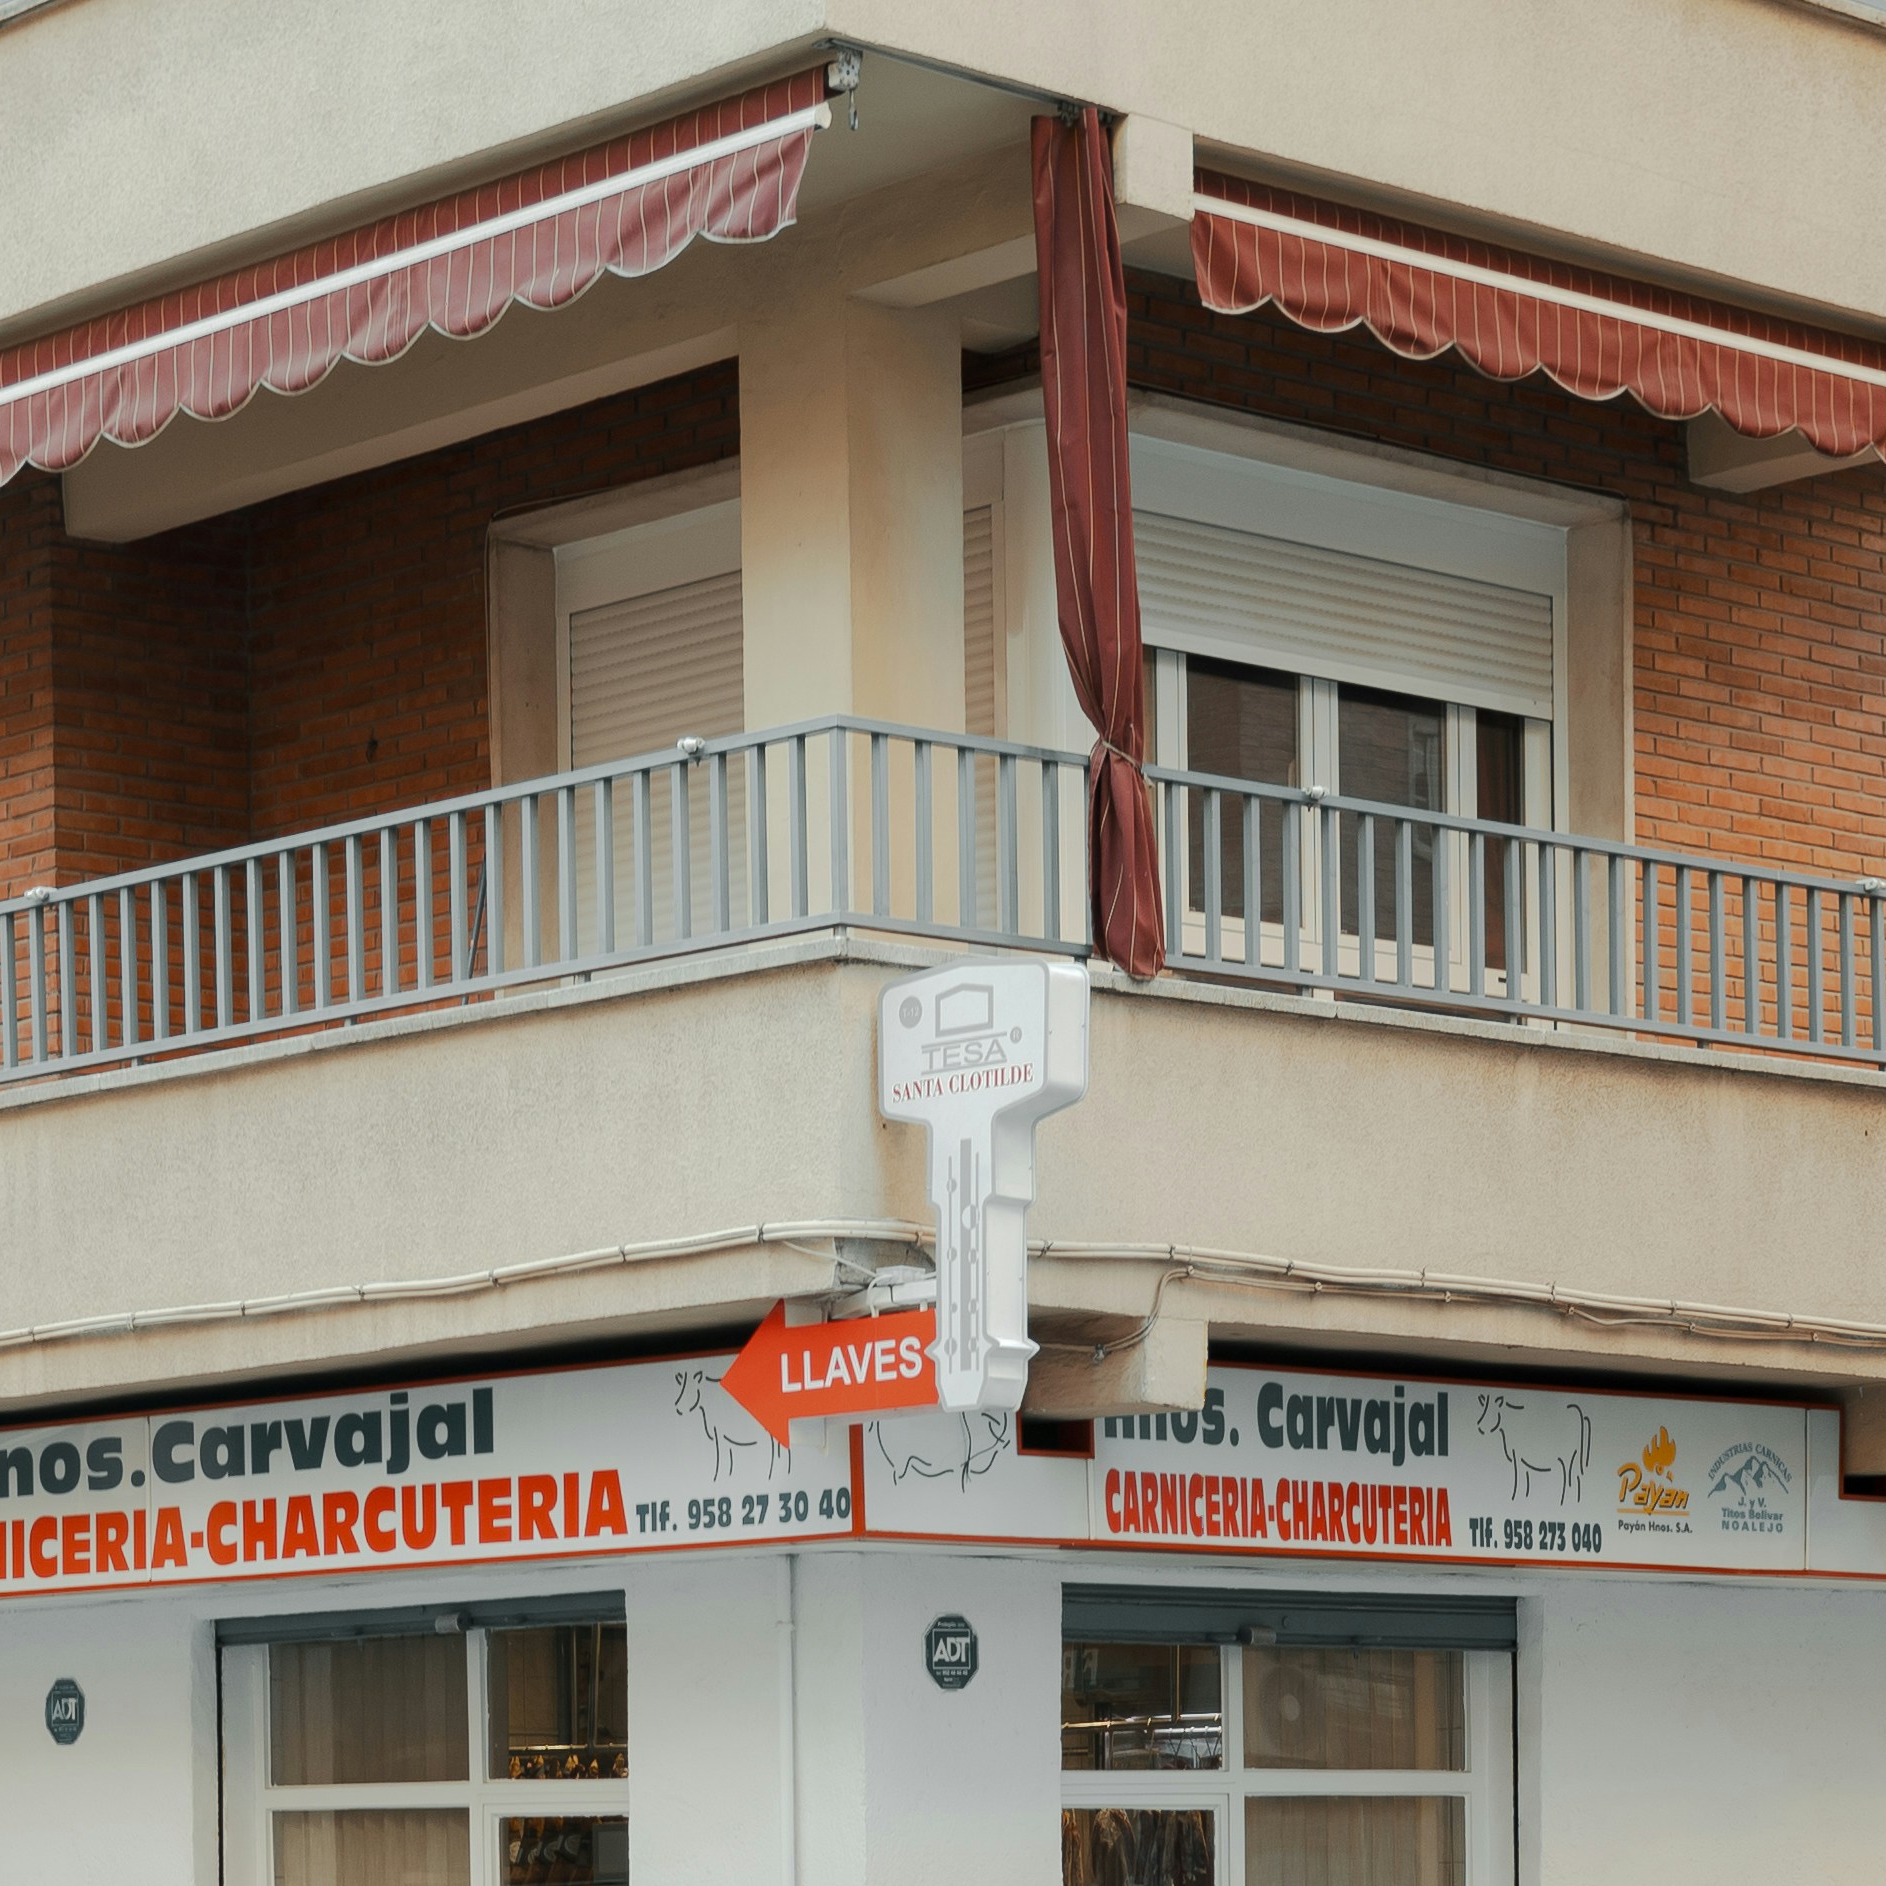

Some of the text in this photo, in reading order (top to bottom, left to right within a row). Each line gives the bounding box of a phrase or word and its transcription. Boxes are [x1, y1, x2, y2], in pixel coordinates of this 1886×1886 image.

[921, 1038, 1008, 1071] TESA
[892, 1062, 1034, 1104] SANTA CLOTILDE
[780, 1336, 923, 1394] LLAVES
[1256, 1382, 1449, 1467] Carvajal
[1707, 1442, 1793, 1484] INDUSTRIAS CARNICAS
[636, 1486, 852, 1533] Tlf. 958 27 30 40
[1105, 1468, 1453, 1548] CARNICERIA-CHARCUTERIA
[1618, 1519, 1693, 1534] Payán Hnos. S.A.
[1721, 1508, 1746, 1519] Titos
[1721, 1520, 1784, 1533] NOALEJO
[1468, 1517, 1602, 1554] Tlf. 958 273 040
[933, 1636, 971, 1663] ADT
[51, 1697, 77, 1721] ADT
